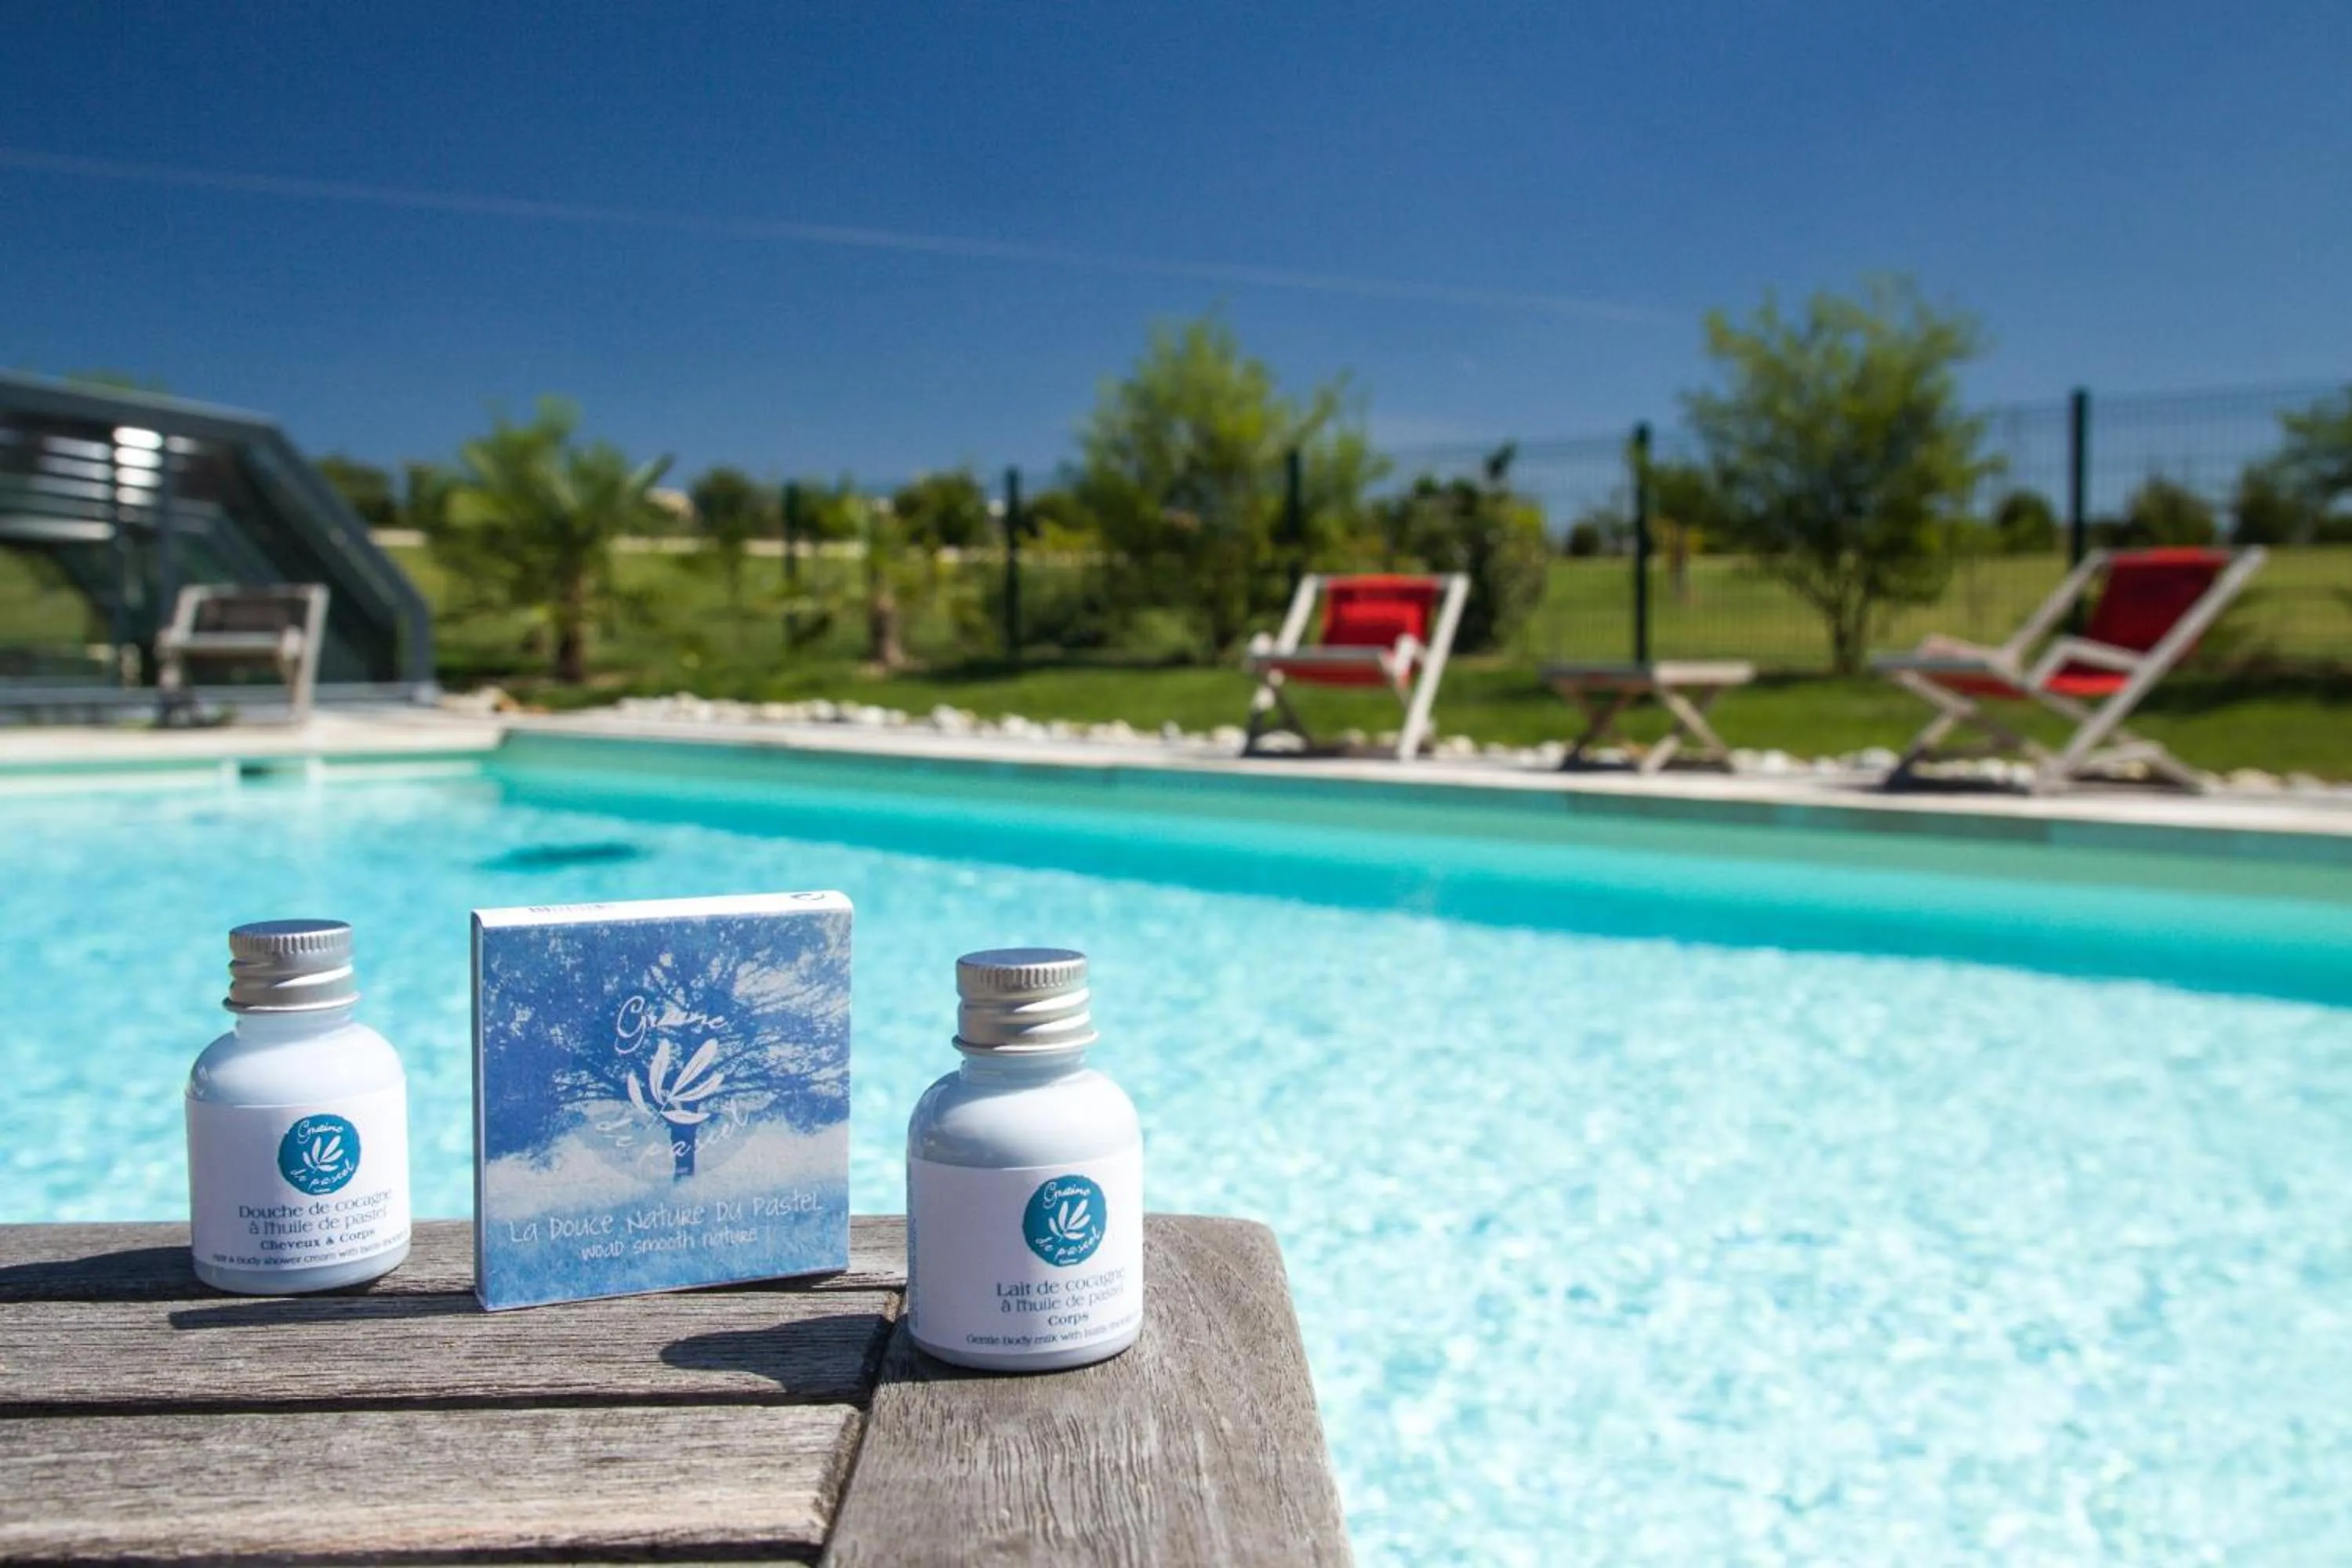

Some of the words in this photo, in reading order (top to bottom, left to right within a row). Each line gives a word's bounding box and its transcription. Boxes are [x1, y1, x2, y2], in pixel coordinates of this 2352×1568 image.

[238, 1203, 303, 1220] Douche
[308, 1202, 331, 1216] de
[335, 1189, 393, 1211] cocagne
[248, 1221, 260, 1236] à
[318, 1216, 339, 1230] de
[345, 1205, 387, 1229] pastel
[510, 1221, 539, 1243] La
[550, 1214, 614, 1240] Douce
[627, 1201, 705, 1234] Nature
[716, 1201, 741, 1222] Du
[260, 1239, 321, 1251] Cheveux
[325, 1236, 335, 1247] &
[339, 1228, 376, 1243] Corps
[633, 1229, 695, 1254] smooth
[702, 1225, 758, 1248] nature
[237, 1255, 261, 1266] body
[264, 1255, 301, 1265] shower
[996, 1281, 1031, 1298] Lait
[1036, 1279, 1059, 1295] de
[1000, 1298, 1011, 1313] à
[1065, 1294, 1085, 1308] de
[1047, 1311, 1089, 1327] Corps
[966, 1332, 1000, 1345] Gentle
[1033, 1334, 1058, 1345] milk
